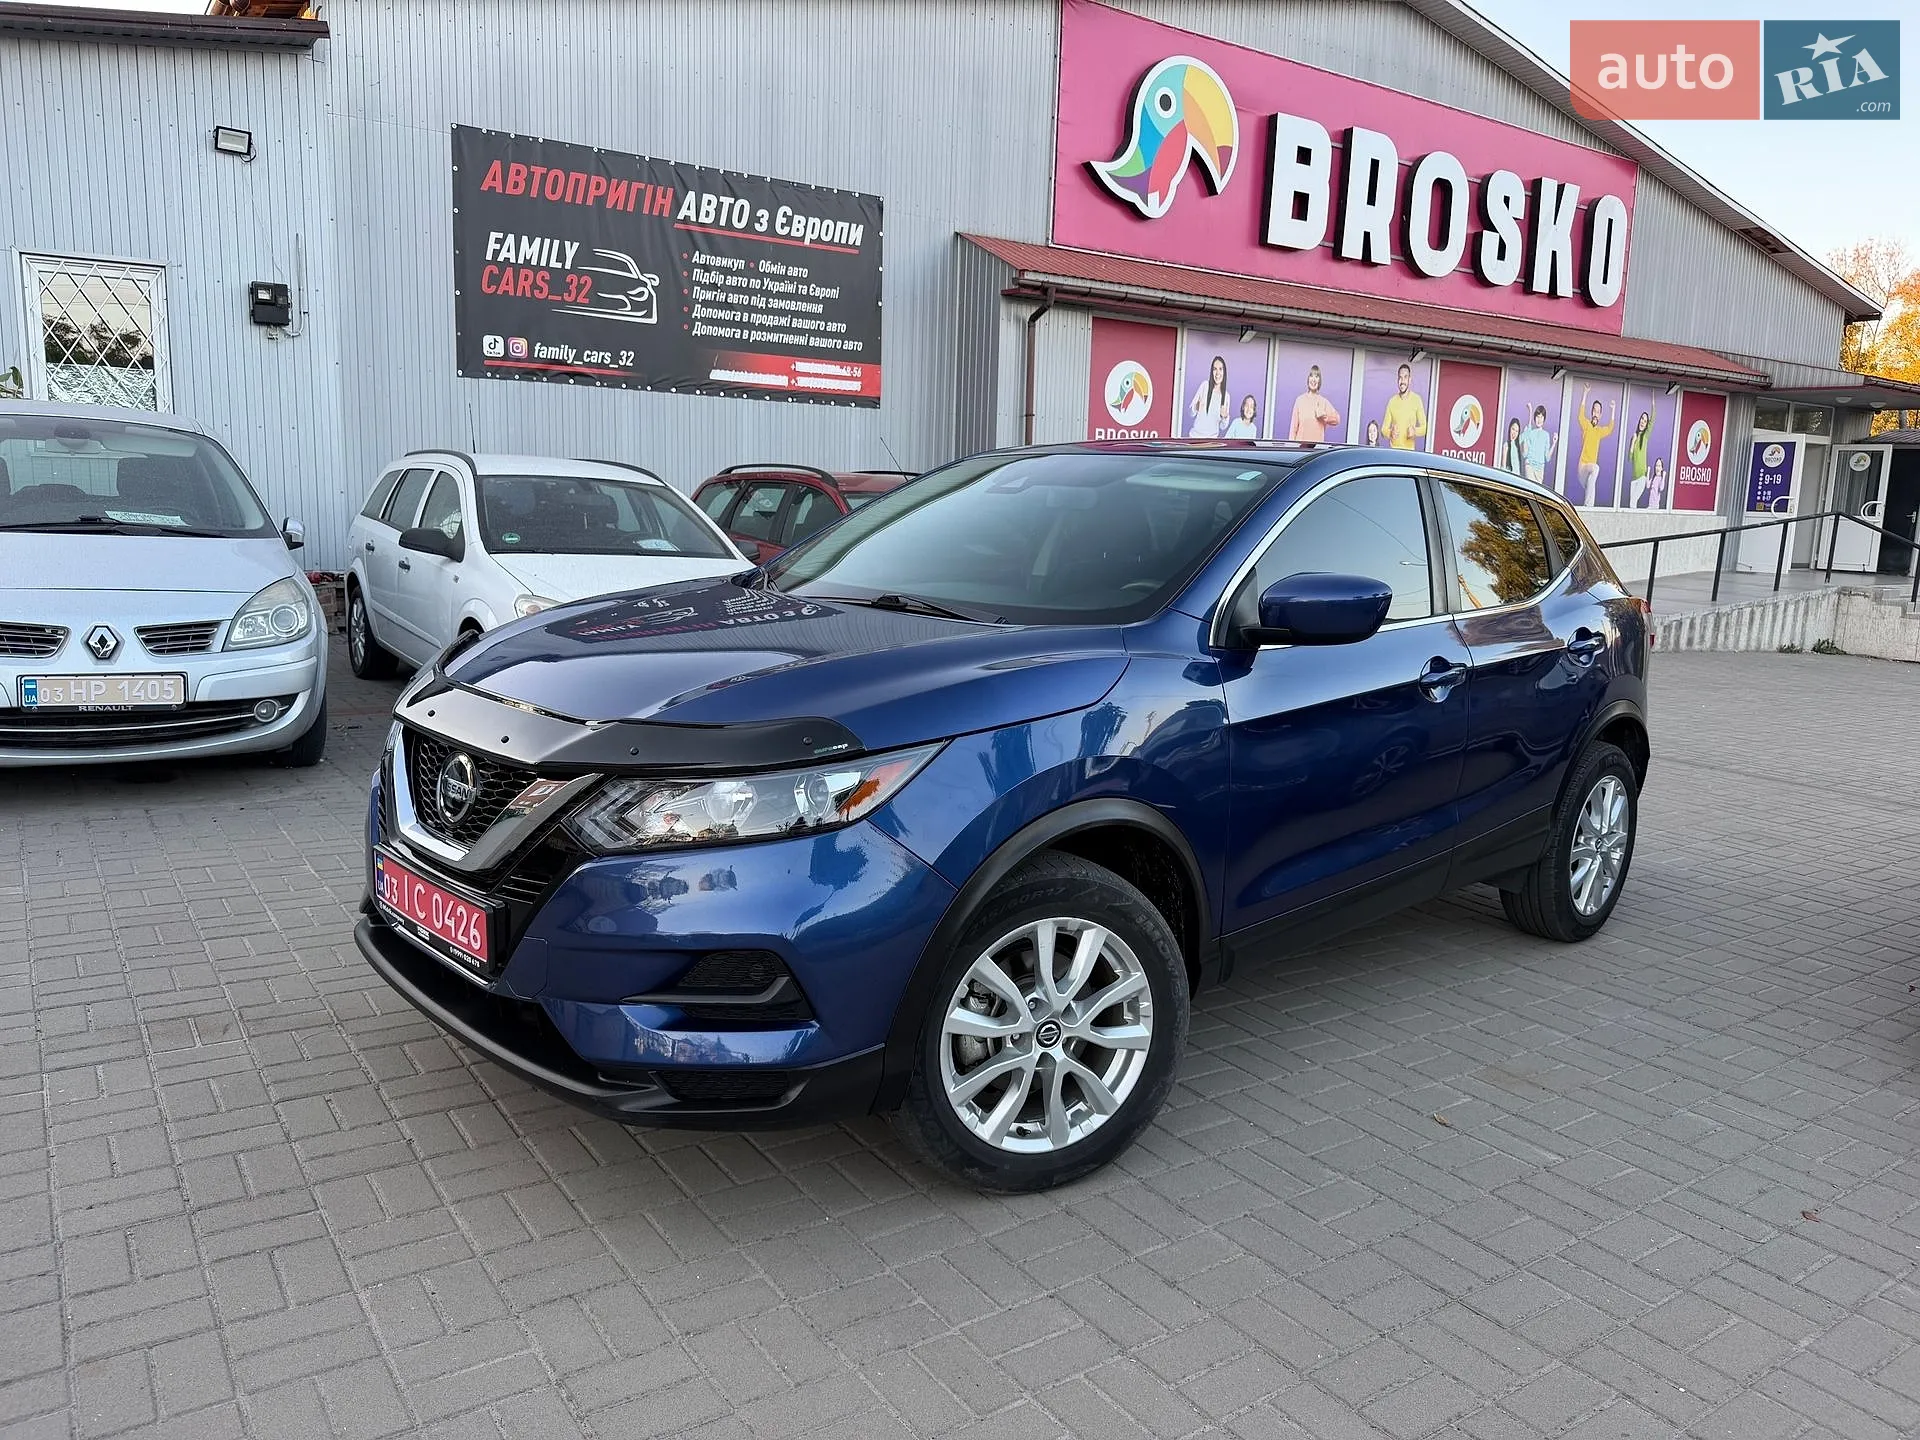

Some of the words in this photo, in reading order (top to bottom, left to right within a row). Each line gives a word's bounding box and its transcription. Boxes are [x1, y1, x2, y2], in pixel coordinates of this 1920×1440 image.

[480, 159, 675, 218] АВТОПРИГІН
[676, 190, 751, 230] АВТО
[754, 208, 770, 233] з
[774, 205, 864, 247] Європи
[1261, 112, 1628, 308] BROSKO
[485, 231, 580, 270] FAMILY
[692, 250, 746, 272] Автовикуп
[758, 259, 786, 275] Обмін
[787, 265, 809, 278] авто
[481, 264, 593, 304] CARS_32
[692, 268, 725, 286] Підбір
[725, 274, 748, 288] авто
[749, 279, 762, 290] по
[762, 277, 797, 295] Україні
[797, 285, 808, 295] та
[808, 283, 840, 300] Європі
[692, 286, 726, 302] Пригін
[727, 292, 750, 305] авто
[750, 293, 767, 310] під
[767, 298, 824, 314] замовлення
[692, 303, 742, 322] Допомога
[750, 312, 791, 328] продажі
[792, 318, 826, 331] вашого
[826, 322, 847, 333] авто
[692, 321, 742, 340] Допомога
[750, 330, 808, 346] розмитненні
[808, 335, 842, 349] вашого
[843, 339, 863, 352] авто
[534, 342, 635, 369] family_cars_32
[1680, 465, 1712, 482] BROSKO
[1764, 474, 1782, 485] 9-19
[25, 695, 37, 703] UA
[39, 688, 64, 703] 03
[70, 679, 106, 702] HP
[117, 680, 176, 701] 1405
[384, 873, 398, 905] 03
[404, 874, 427, 920] IC
[432, 892, 482, 951] 0426
